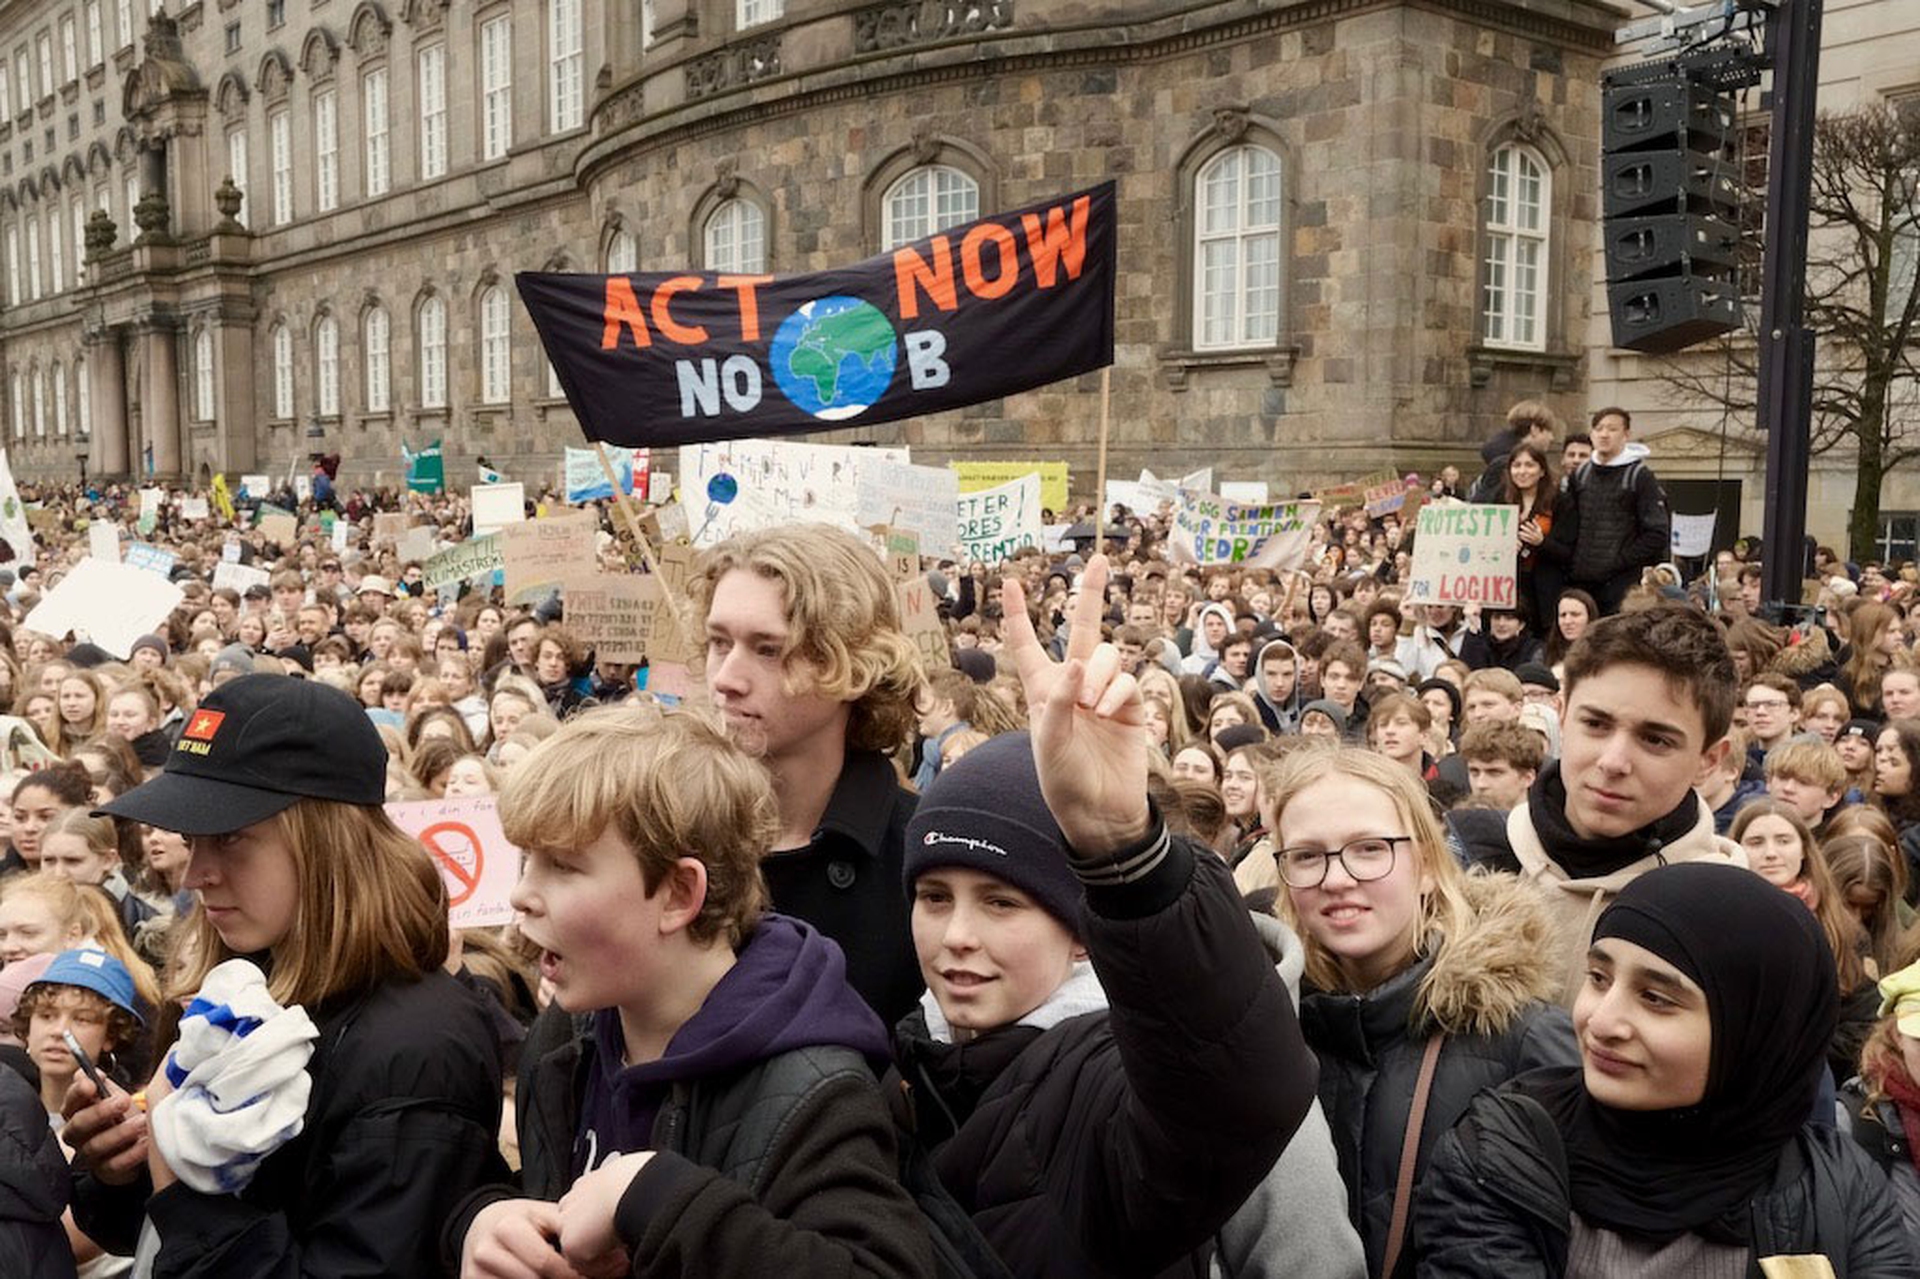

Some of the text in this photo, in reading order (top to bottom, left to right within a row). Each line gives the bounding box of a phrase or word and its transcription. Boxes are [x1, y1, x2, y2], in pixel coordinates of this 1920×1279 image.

[602, 195, 1090, 349] ACT NOW
[675, 329, 950, 417] NO B
[957, 497, 978, 518] ET
[1226, 503, 1298, 522] SAMMEN
[957, 516, 1002, 539] ORES
[1418, 508, 1511, 537] PROTEST!
[1195, 535, 1267, 563] BEDRE
[1413, 574, 1515, 606] FOR LOGIK?
[190, 741, 211, 757] NAM
[924, 831, 1007, 855] Champion
